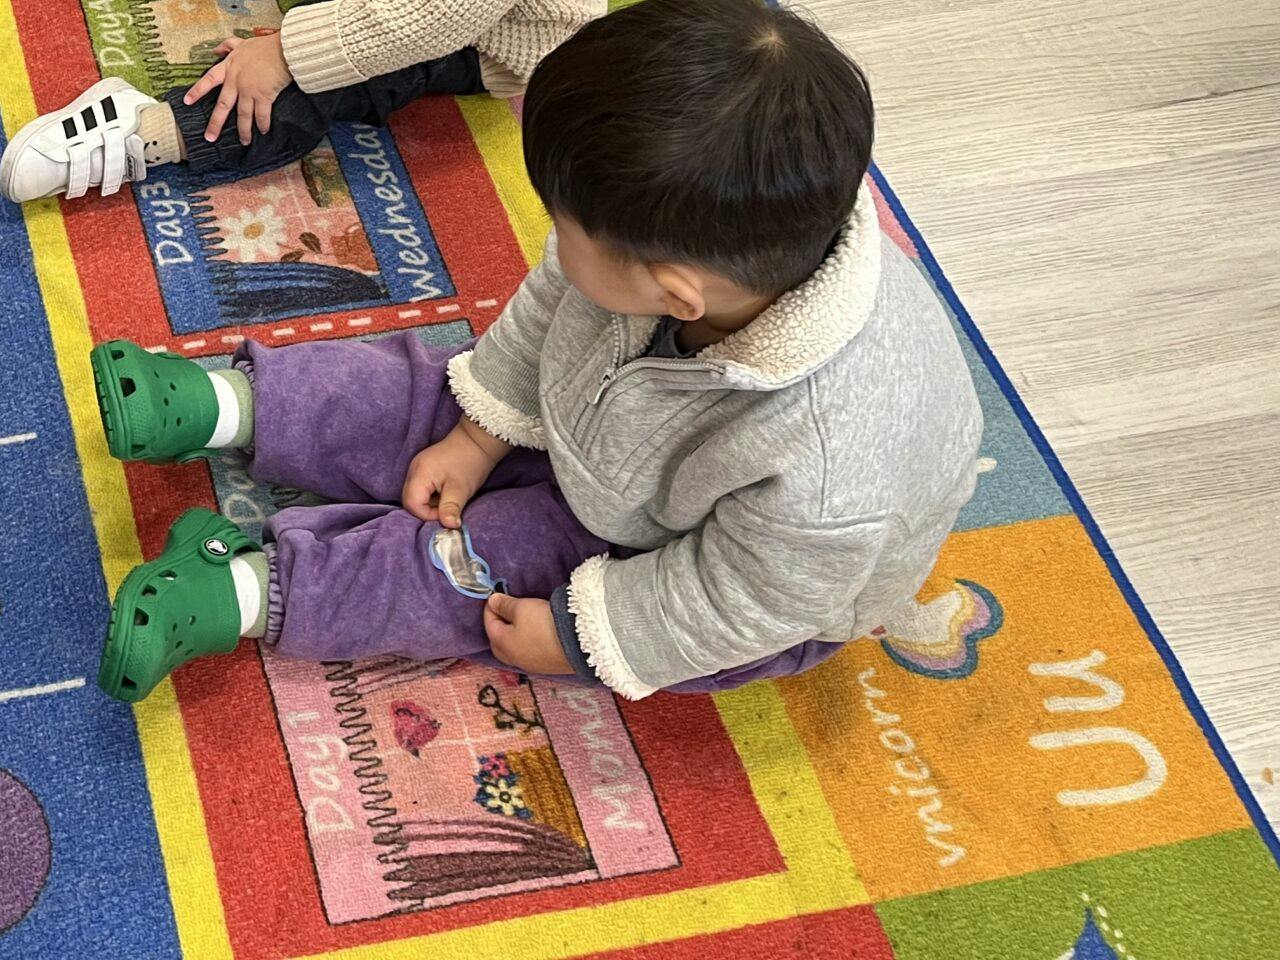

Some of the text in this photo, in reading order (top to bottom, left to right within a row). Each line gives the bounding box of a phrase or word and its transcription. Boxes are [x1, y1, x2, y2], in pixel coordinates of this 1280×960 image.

[552, 683, 648, 831] Mond
[857, 666, 969, 869] unicorn
[1027, 649, 1168, 806] Uu
